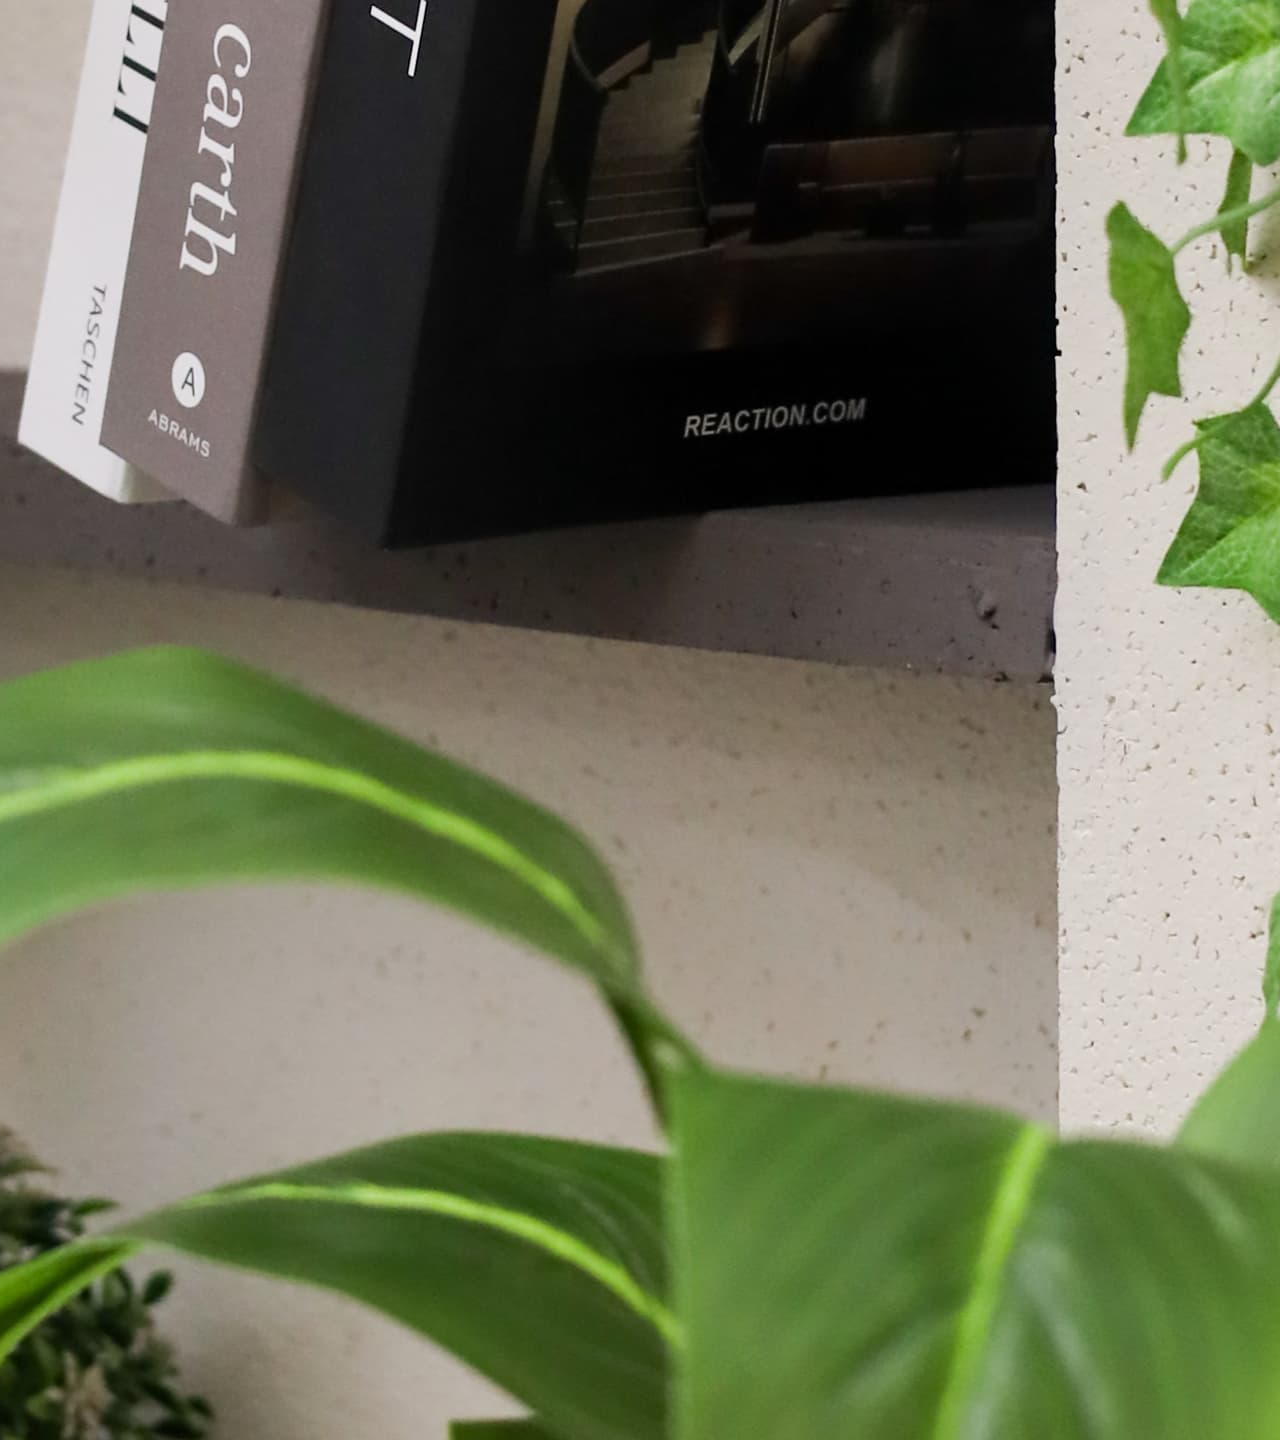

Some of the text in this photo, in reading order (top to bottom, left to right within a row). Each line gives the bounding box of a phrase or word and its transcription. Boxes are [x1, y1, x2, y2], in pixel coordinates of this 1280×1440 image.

[71, 284, 108, 426] TASCHEN
[180, 366, 196, 398] A
[147, 408, 211, 458] ABRAMS
[682, 397, 867, 438] REACTION.COM
